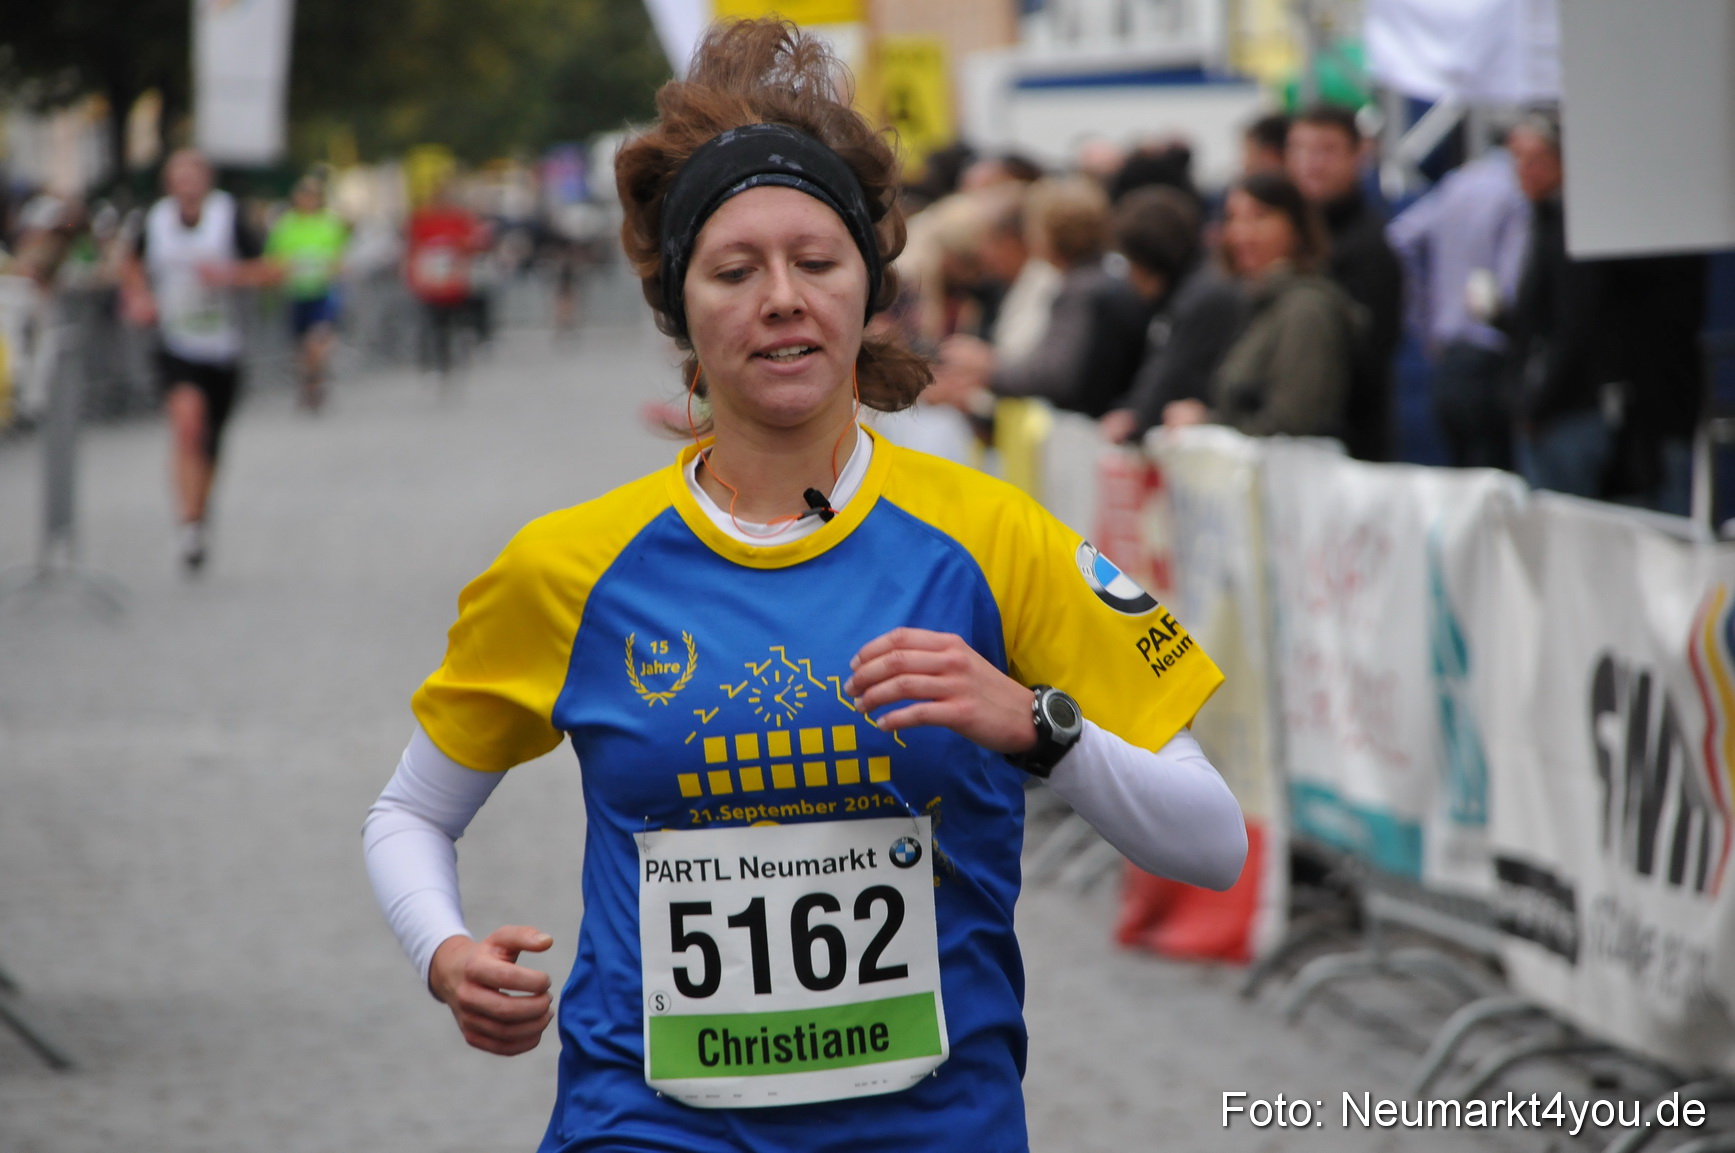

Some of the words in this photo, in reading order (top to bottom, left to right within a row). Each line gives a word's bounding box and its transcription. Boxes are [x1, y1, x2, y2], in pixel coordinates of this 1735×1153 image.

[650, 640, 669, 655] 15
[640, 659, 681, 677] Jahre
[689, 799, 837, 824] 21.September
[844, 794, 896, 812] 2014
[645, 858, 732, 883] PARTL
[739, 847, 878, 879] Neumarkt
[669, 884, 909, 999] 5162
[654, 994, 665, 1012] S
[697, 1021, 890, 1068] Christiane
